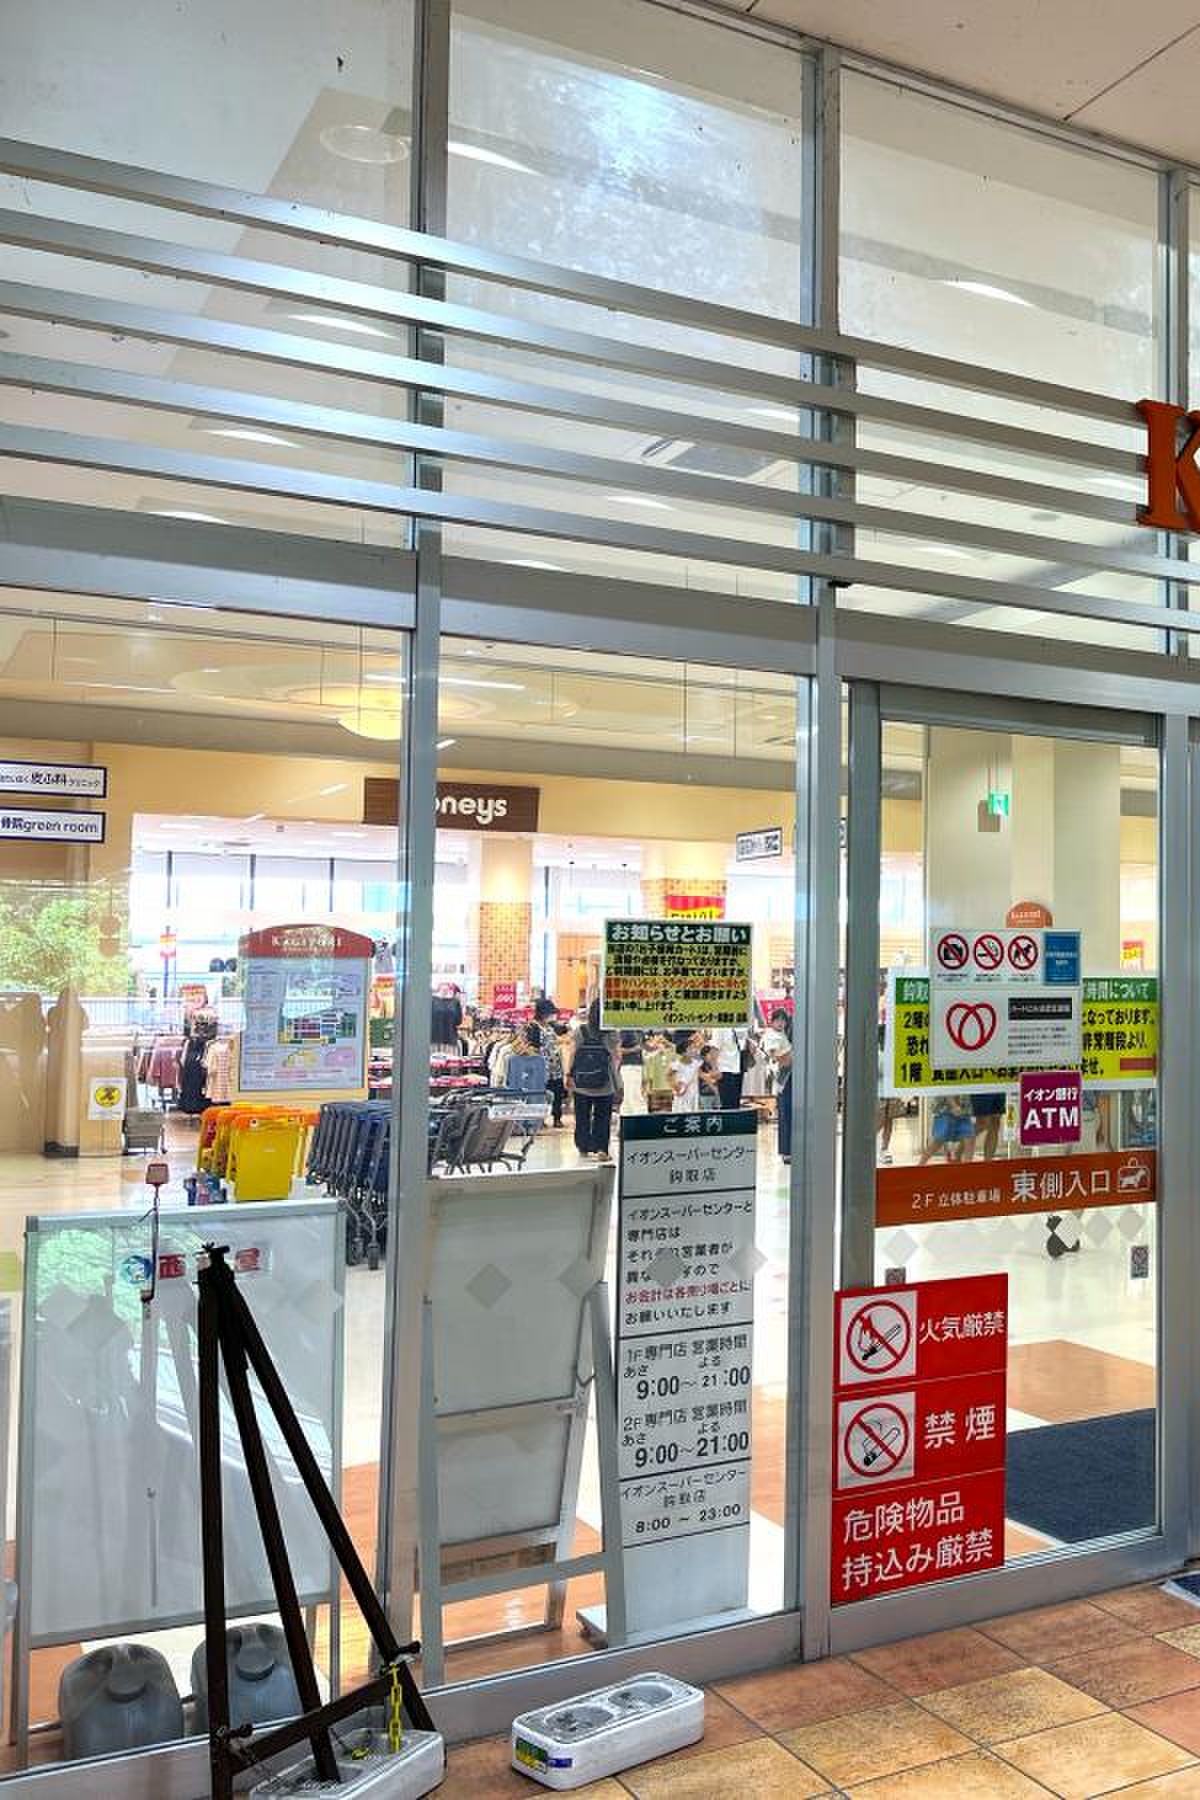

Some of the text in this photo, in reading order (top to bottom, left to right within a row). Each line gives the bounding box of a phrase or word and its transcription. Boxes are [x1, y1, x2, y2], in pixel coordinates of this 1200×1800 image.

[611, 924, 747, 943] お知らせとお願い
[1023, 1087, 1079, 1102] イオン銀行
[663, 1116, 723, 1134] ご案内
[1023, 1105, 1080, 1131] ATM
[627, 1148, 754, 1166] イオンスーパーセンター
[1011, 1169, 1111, 1202] 東側入口
[628, 1200, 752, 1222] イオンスーパーセンターと
[627, 1226, 681, 1242] 専門店は
[627, 1242, 733, 1264] それれ営業者が
[627, 1263, 720, 1284] 異なすので
[625, 1301, 731, 1325] お願いいたします
[920, 1311, 1004, 1344] 火気厳禁
[924, 1404, 995, 1449] 禁煙
[622, 1470, 746, 1500] イオンスーパーセンター
[635, 1517, 671, 1534] 8:00
[699, 1503, 741, 1521] 23:00
[843, 1490, 964, 1545] 危険物品
[842, 1527, 993, 1591] 持込み厳禁
